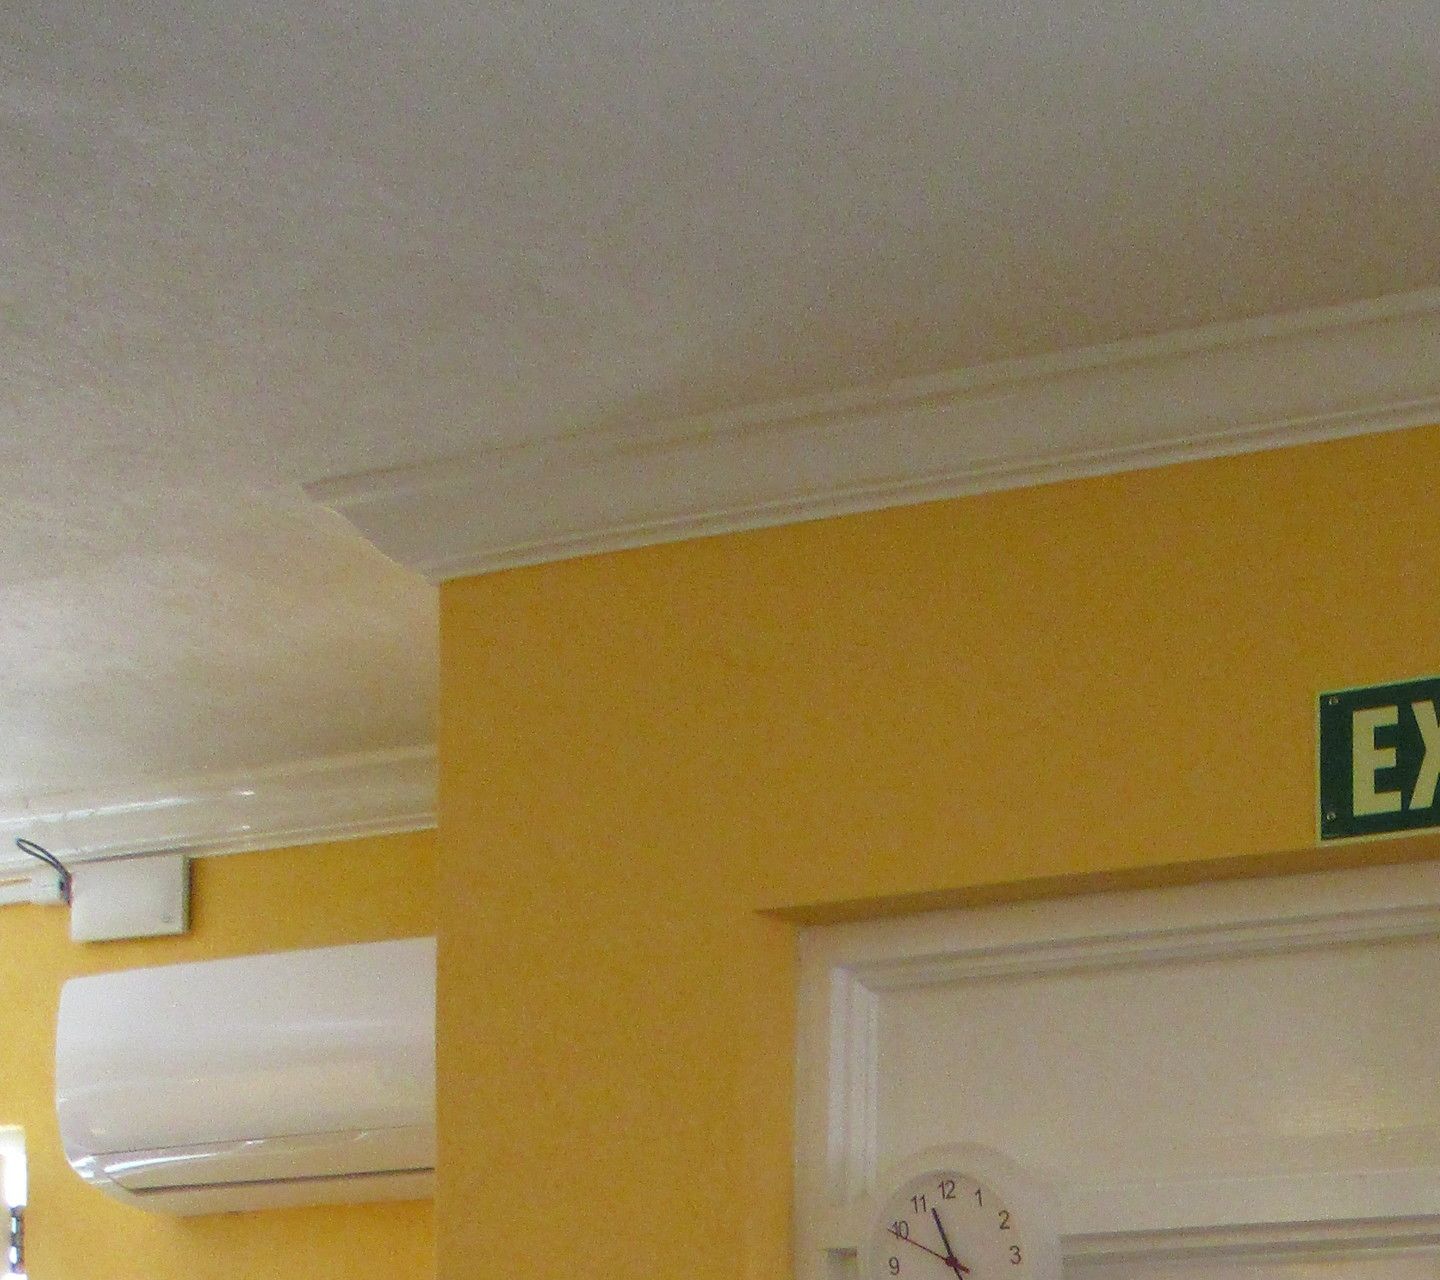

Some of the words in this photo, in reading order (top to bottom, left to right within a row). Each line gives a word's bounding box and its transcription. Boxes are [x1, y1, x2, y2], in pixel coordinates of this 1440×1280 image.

[938, 1180, 956, 1200] 12
[974, 1188, 983, 1207] 1
[911, 1194, 927, 1214] 11
[999, 1210, 1011, 1230] 2
[1010, 1245, 1022, 1265] 3
[888, 1256, 900, 1276] 9
